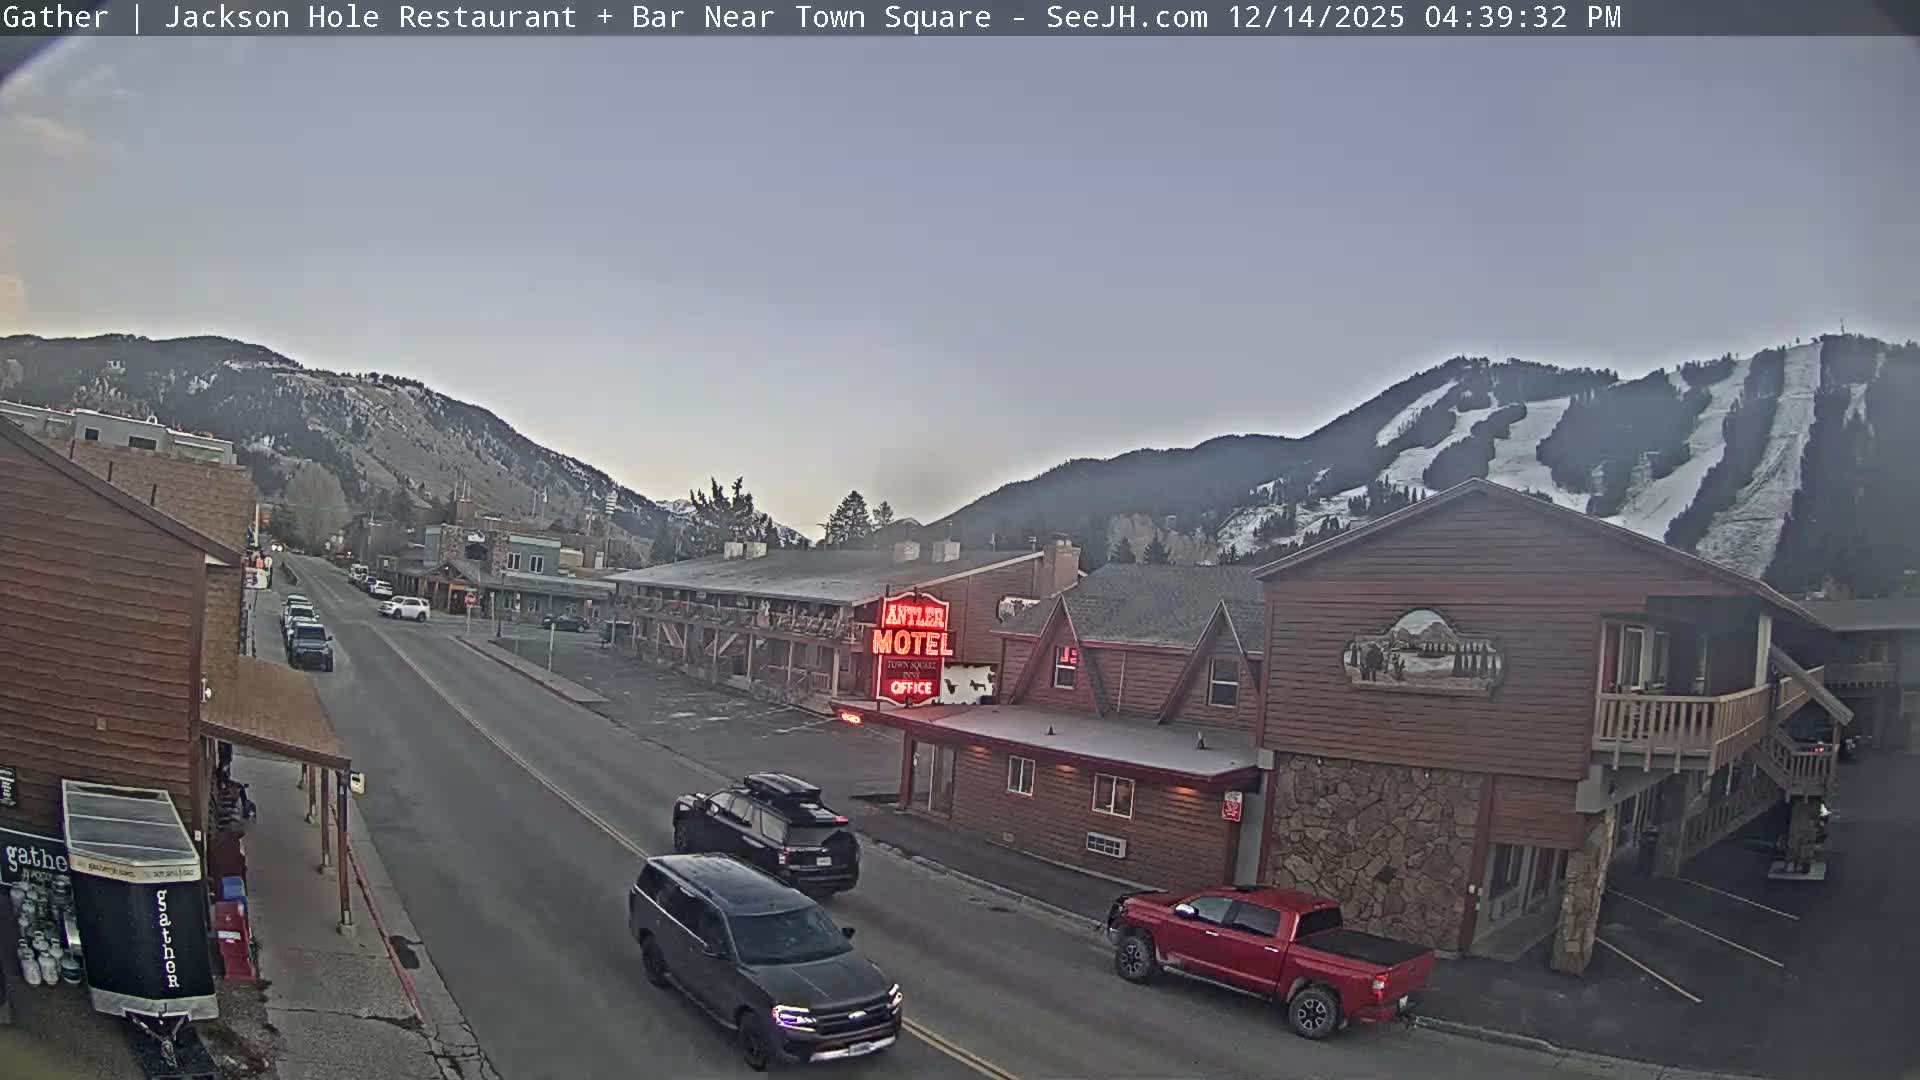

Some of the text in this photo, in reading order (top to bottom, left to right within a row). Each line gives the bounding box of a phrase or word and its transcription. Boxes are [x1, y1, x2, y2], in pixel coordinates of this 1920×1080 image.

[885, 604, 945, 628] ANTLER
[872, 629, 954, 656] MOTEL
[890, 680, 933, 695] OFFICE
[6, 845, 68, 872] gathe
